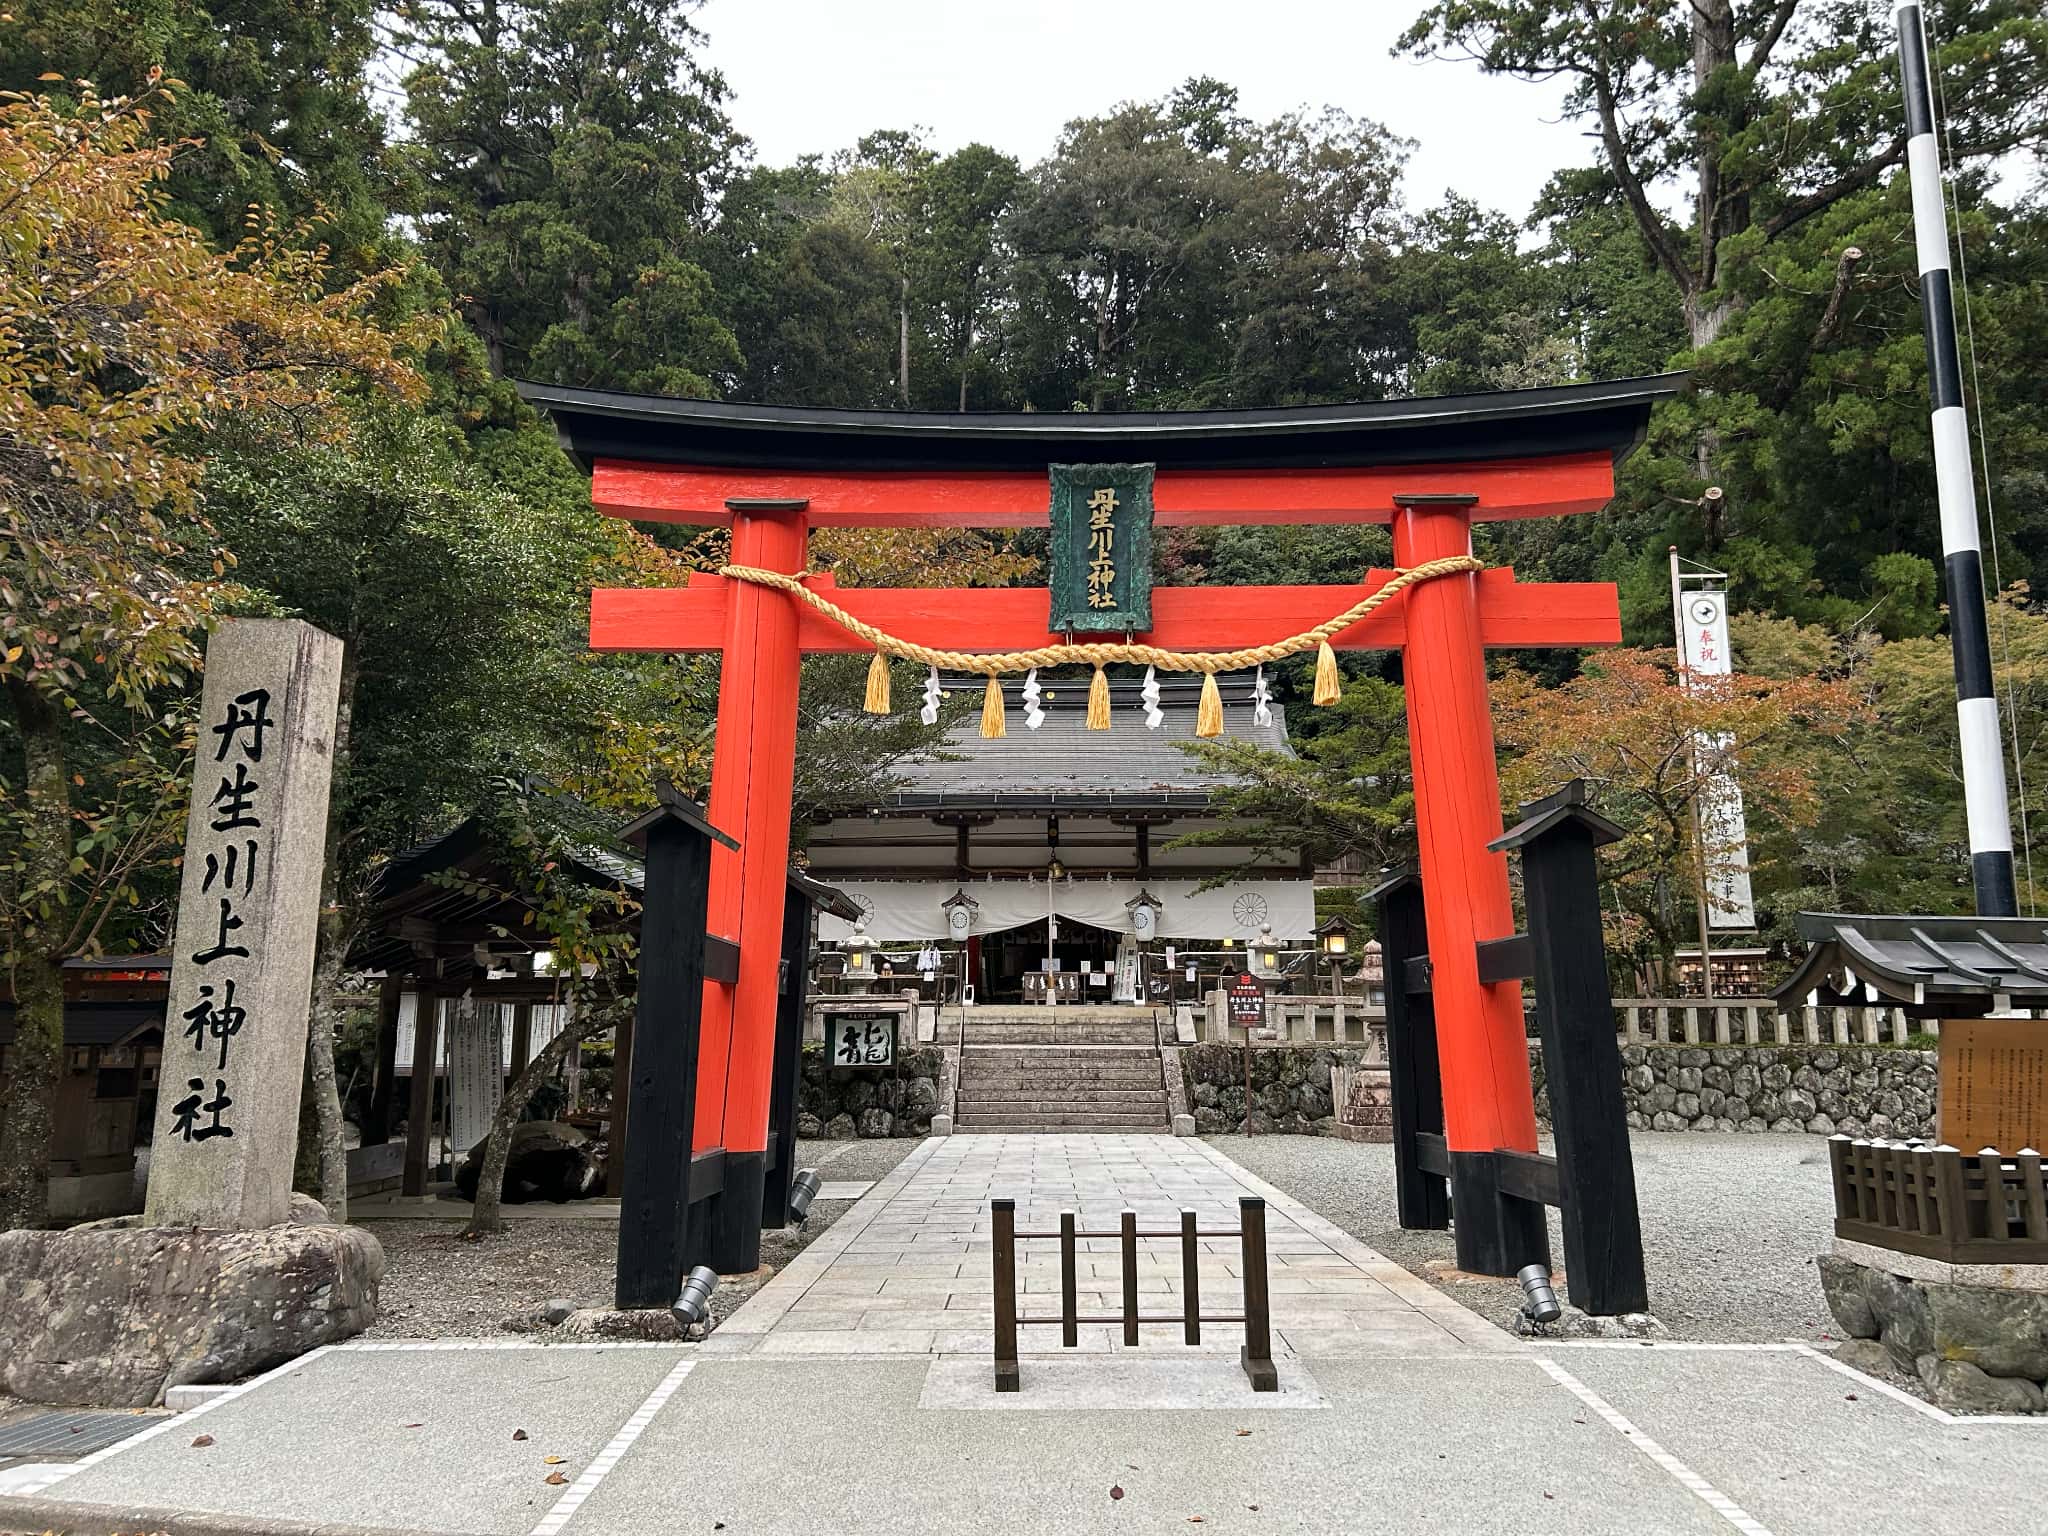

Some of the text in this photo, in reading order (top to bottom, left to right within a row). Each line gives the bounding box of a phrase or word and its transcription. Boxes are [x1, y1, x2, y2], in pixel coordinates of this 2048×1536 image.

[1086, 487, 1120, 609] 丹生川上神社
[1699, 628, 1719, 663] 奉祝
[167, 688, 274, 1144] 丹生川上神社
